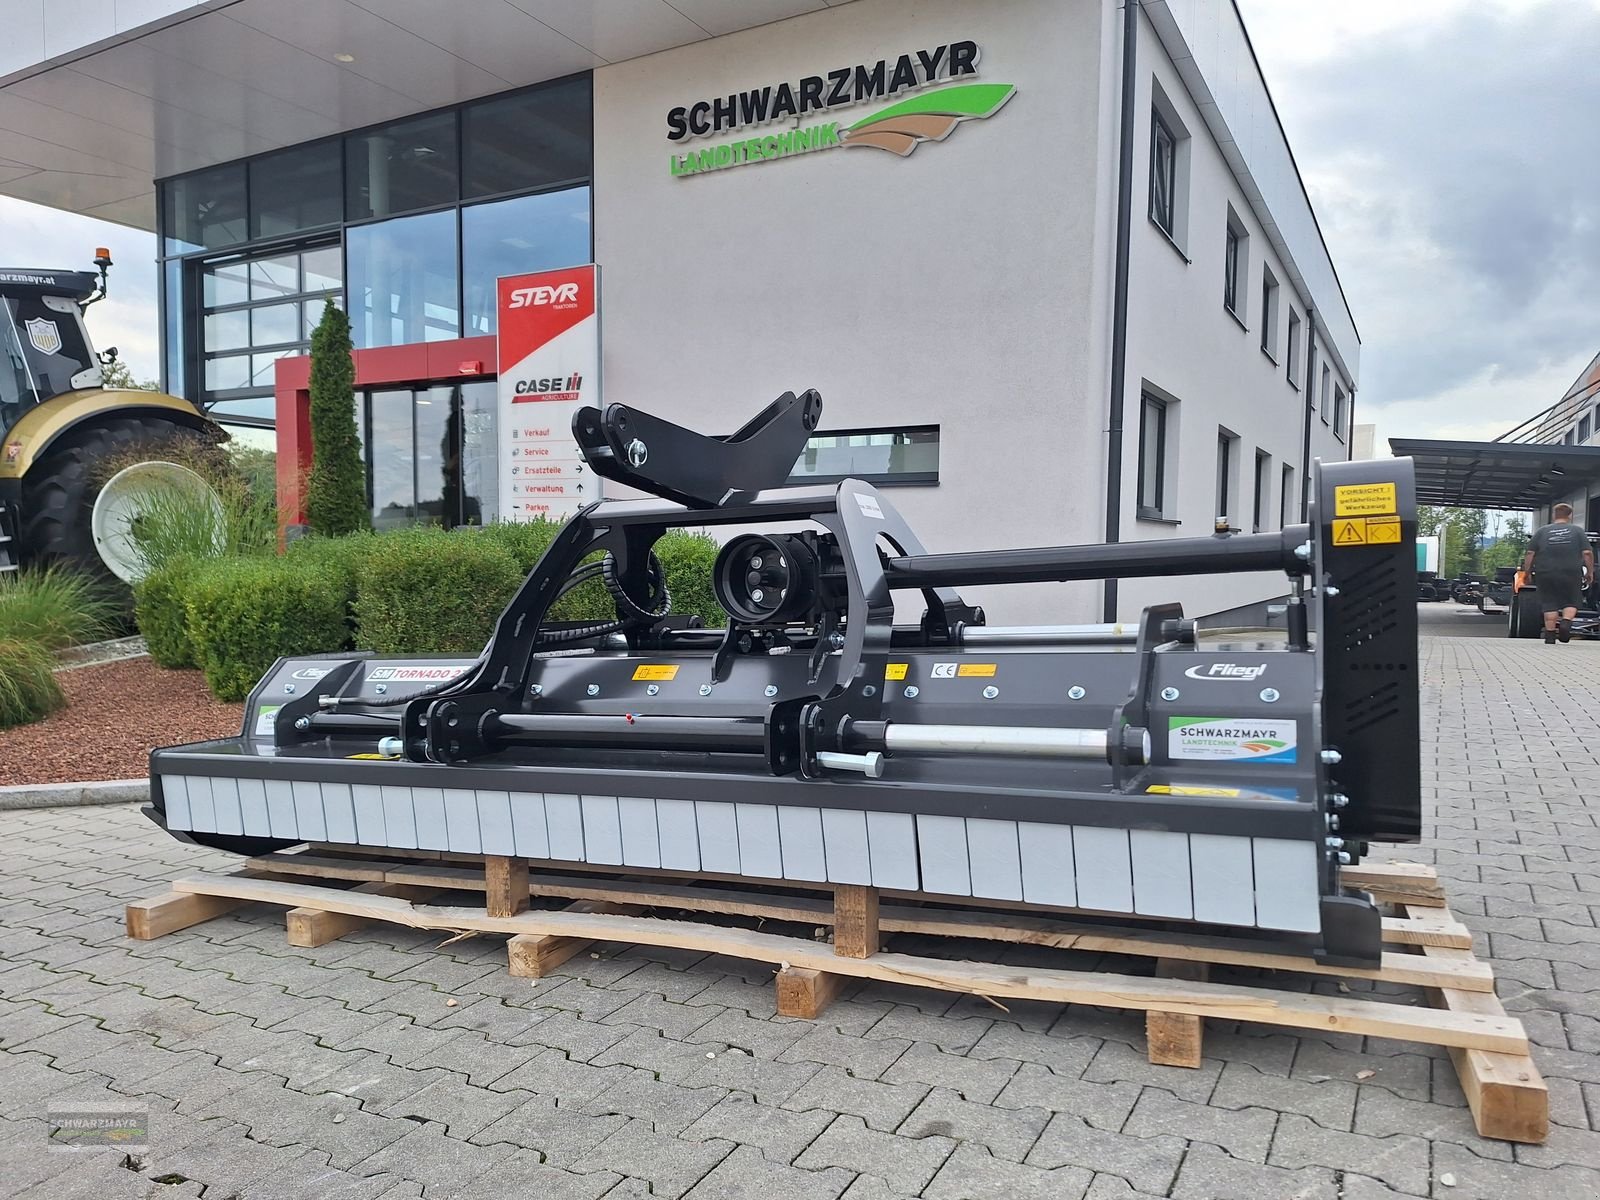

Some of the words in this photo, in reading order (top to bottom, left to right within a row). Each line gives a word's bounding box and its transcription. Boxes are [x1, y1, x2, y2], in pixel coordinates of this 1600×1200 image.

[667, 39, 981, 141] SCHWARZMAYR
[669, 121, 841, 177] LANDTECHNIK
[508, 282, 579, 309] STEYR
[515, 378, 563, 394] CASE
[541, 393, 578, 401] AGRICULTURE
[524, 428, 550, 437] Verkauf
[524, 447, 549, 456] Service
[524, 465, 562, 474] Ersatzteile
[525, 484, 564, 494] Verwaltung
[525, 503, 550, 511] Parken
[394, 669, 451, 679] TORNADO
[1208, 663, 1268, 681] Fliegl
[1180, 727, 1278, 739] SCHWARZMAYR
[1181, 738, 1238, 746] LANDTECHNIK
